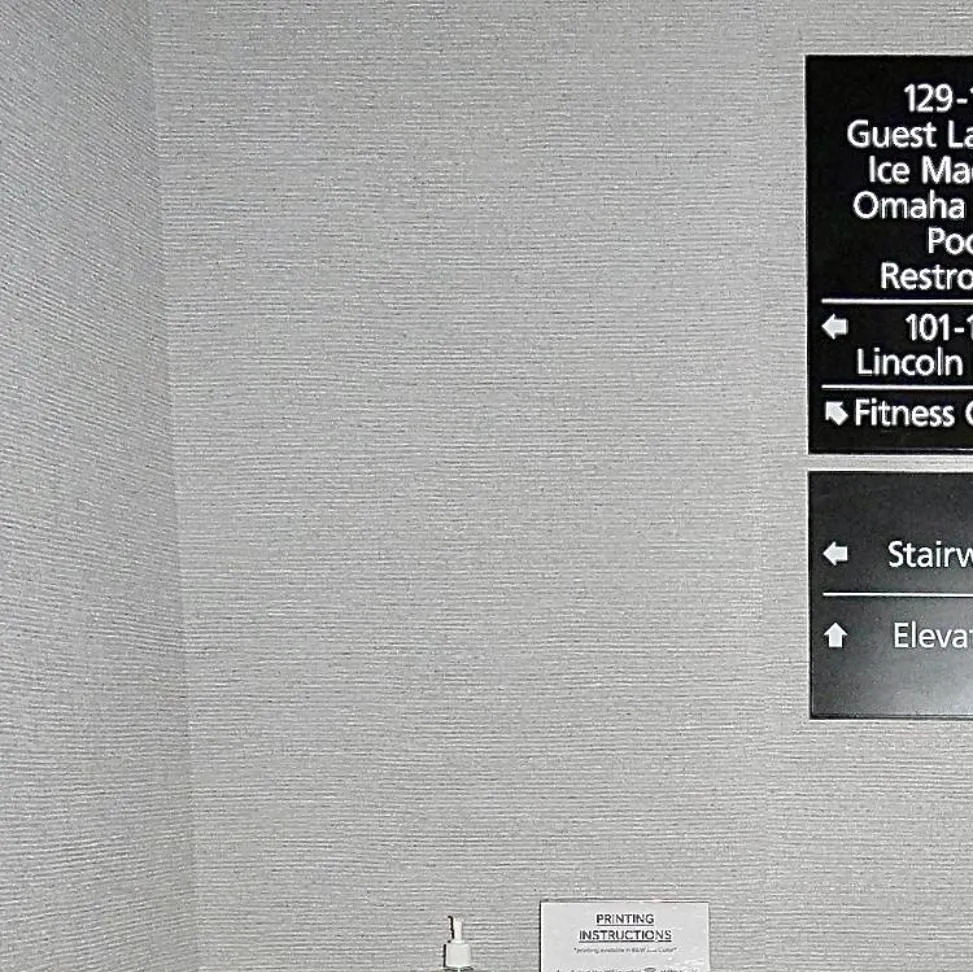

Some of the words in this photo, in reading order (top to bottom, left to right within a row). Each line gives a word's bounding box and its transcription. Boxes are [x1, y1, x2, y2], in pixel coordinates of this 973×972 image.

[847, 119, 937, 148] Guest
[868, 156, 910, 184] Ice
[853, 190, 966, 220] Omaha
[856, 346, 964, 376] Lincoln
[854, 398, 955, 427] Fitness
[596, 913, 655, 925] PRINTING
[579, 929, 672, 941] INSTRUCTIONS
